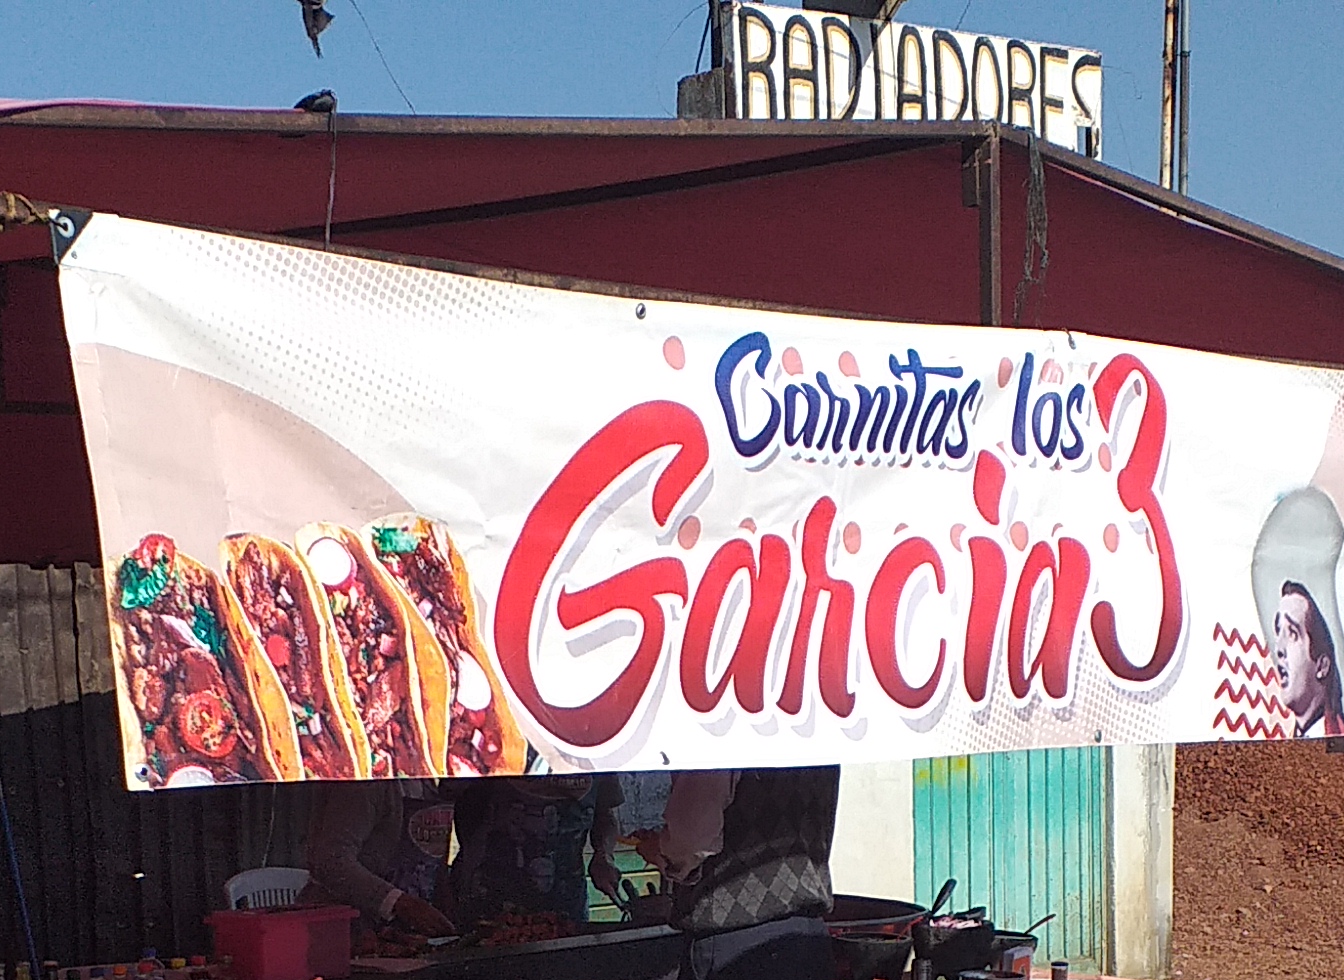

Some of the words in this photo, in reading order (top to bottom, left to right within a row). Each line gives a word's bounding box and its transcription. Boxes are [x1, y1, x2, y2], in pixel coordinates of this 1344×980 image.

[715, 332, 979, 457] Carnitas
[1012, 352, 1085, 460] los
[1091, 353, 1183, 682] 3
